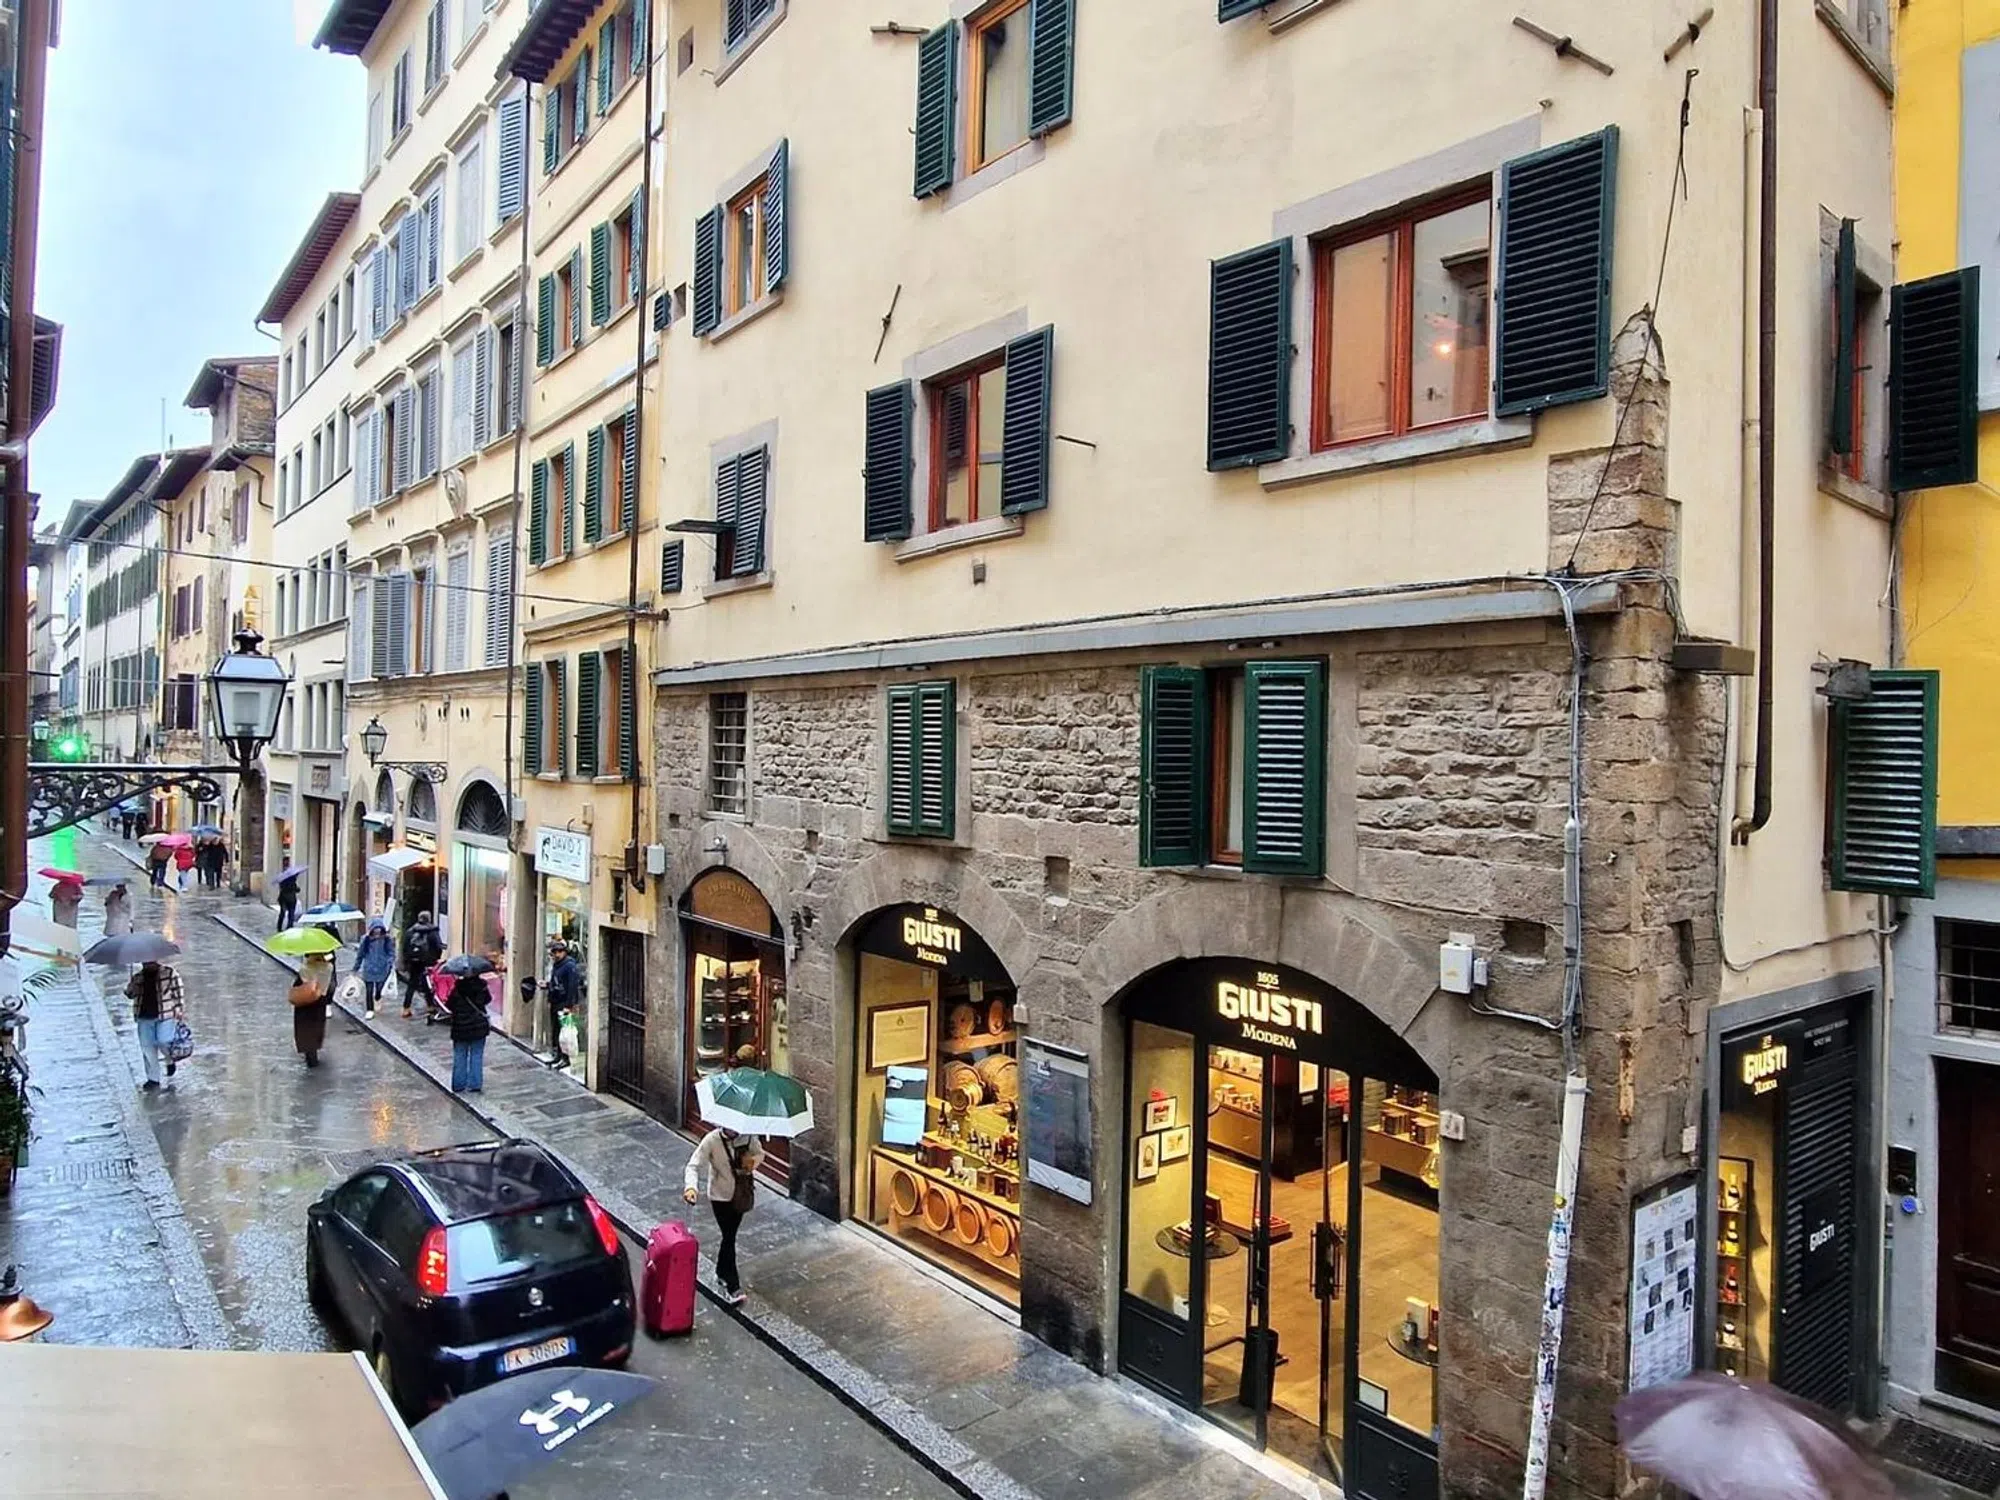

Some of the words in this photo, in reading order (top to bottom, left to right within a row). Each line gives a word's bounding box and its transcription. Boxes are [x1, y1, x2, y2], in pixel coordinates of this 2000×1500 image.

[903, 917, 961, 953] GIUSTI
[1257, 971, 1280, 985] 1605
[1218, 981, 1323, 1035] GIUSTI
[1743, 1045, 1787, 1085] GIUSTI
[1809, 1223, 1835, 1252] GIUSTI
